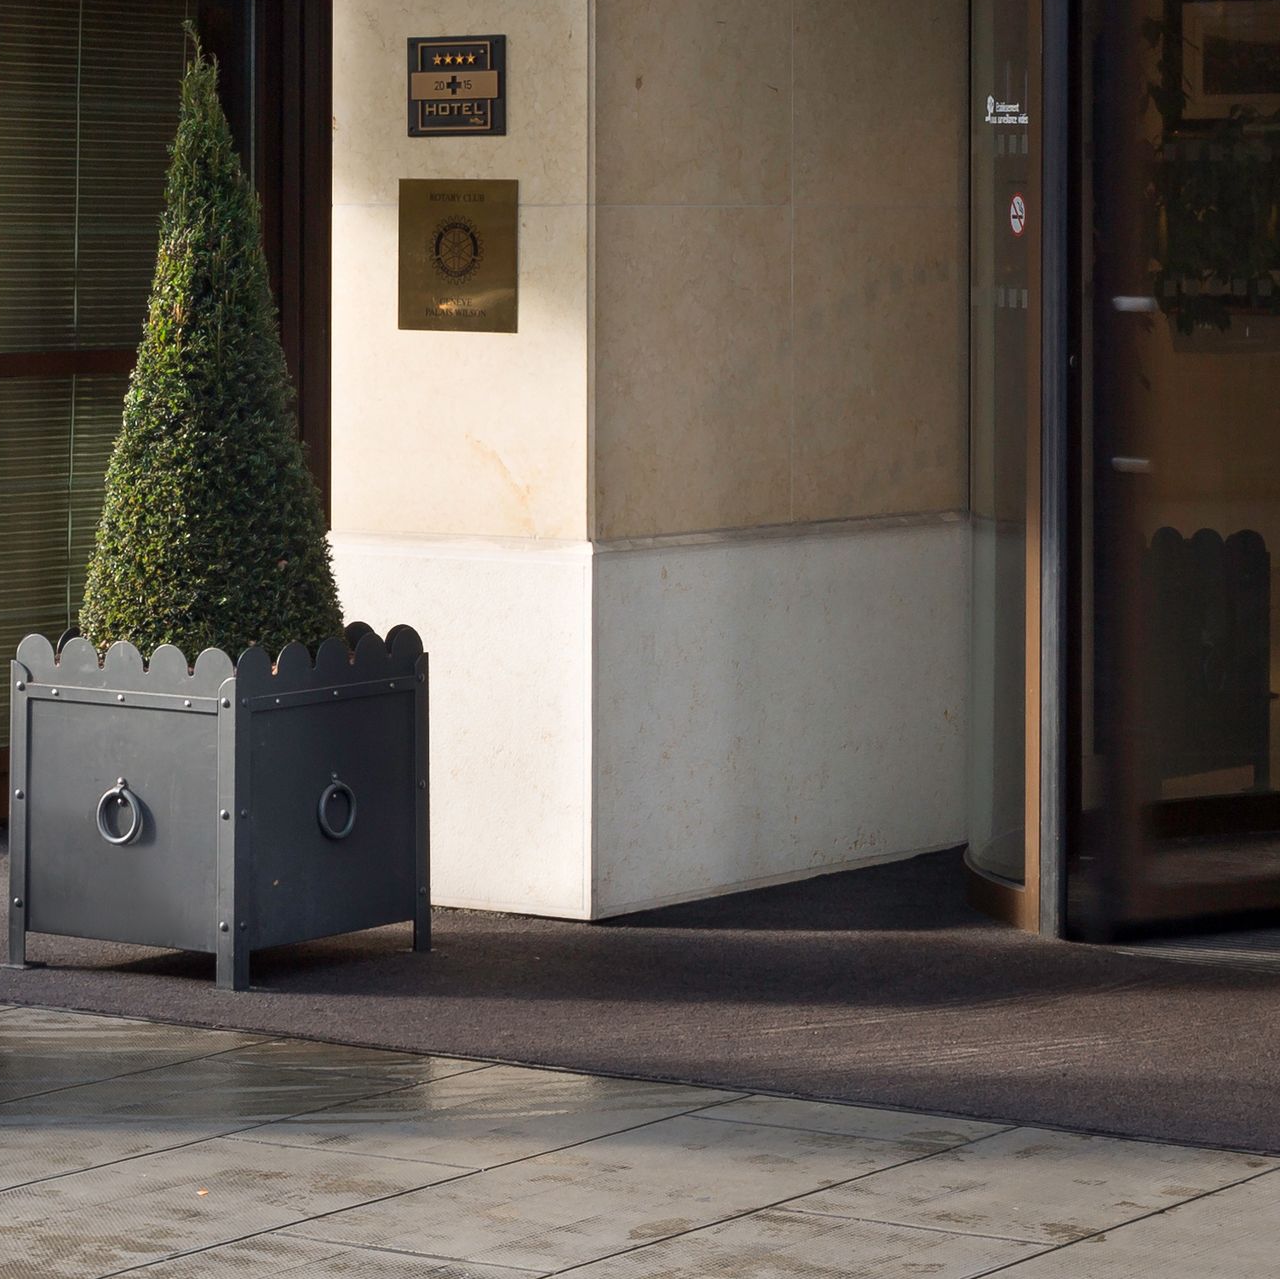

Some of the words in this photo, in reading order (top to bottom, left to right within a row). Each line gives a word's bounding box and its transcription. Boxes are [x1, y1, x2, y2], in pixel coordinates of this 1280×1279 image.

[434, 80, 446, 91] 20
[463, 79, 473, 90] 15
[425, 103, 484, 116] HOTEL
[429, 192, 461, 202] ROTARY
[463, 192, 486, 202] CLUB
[455, 308, 487, 318] WILSON
